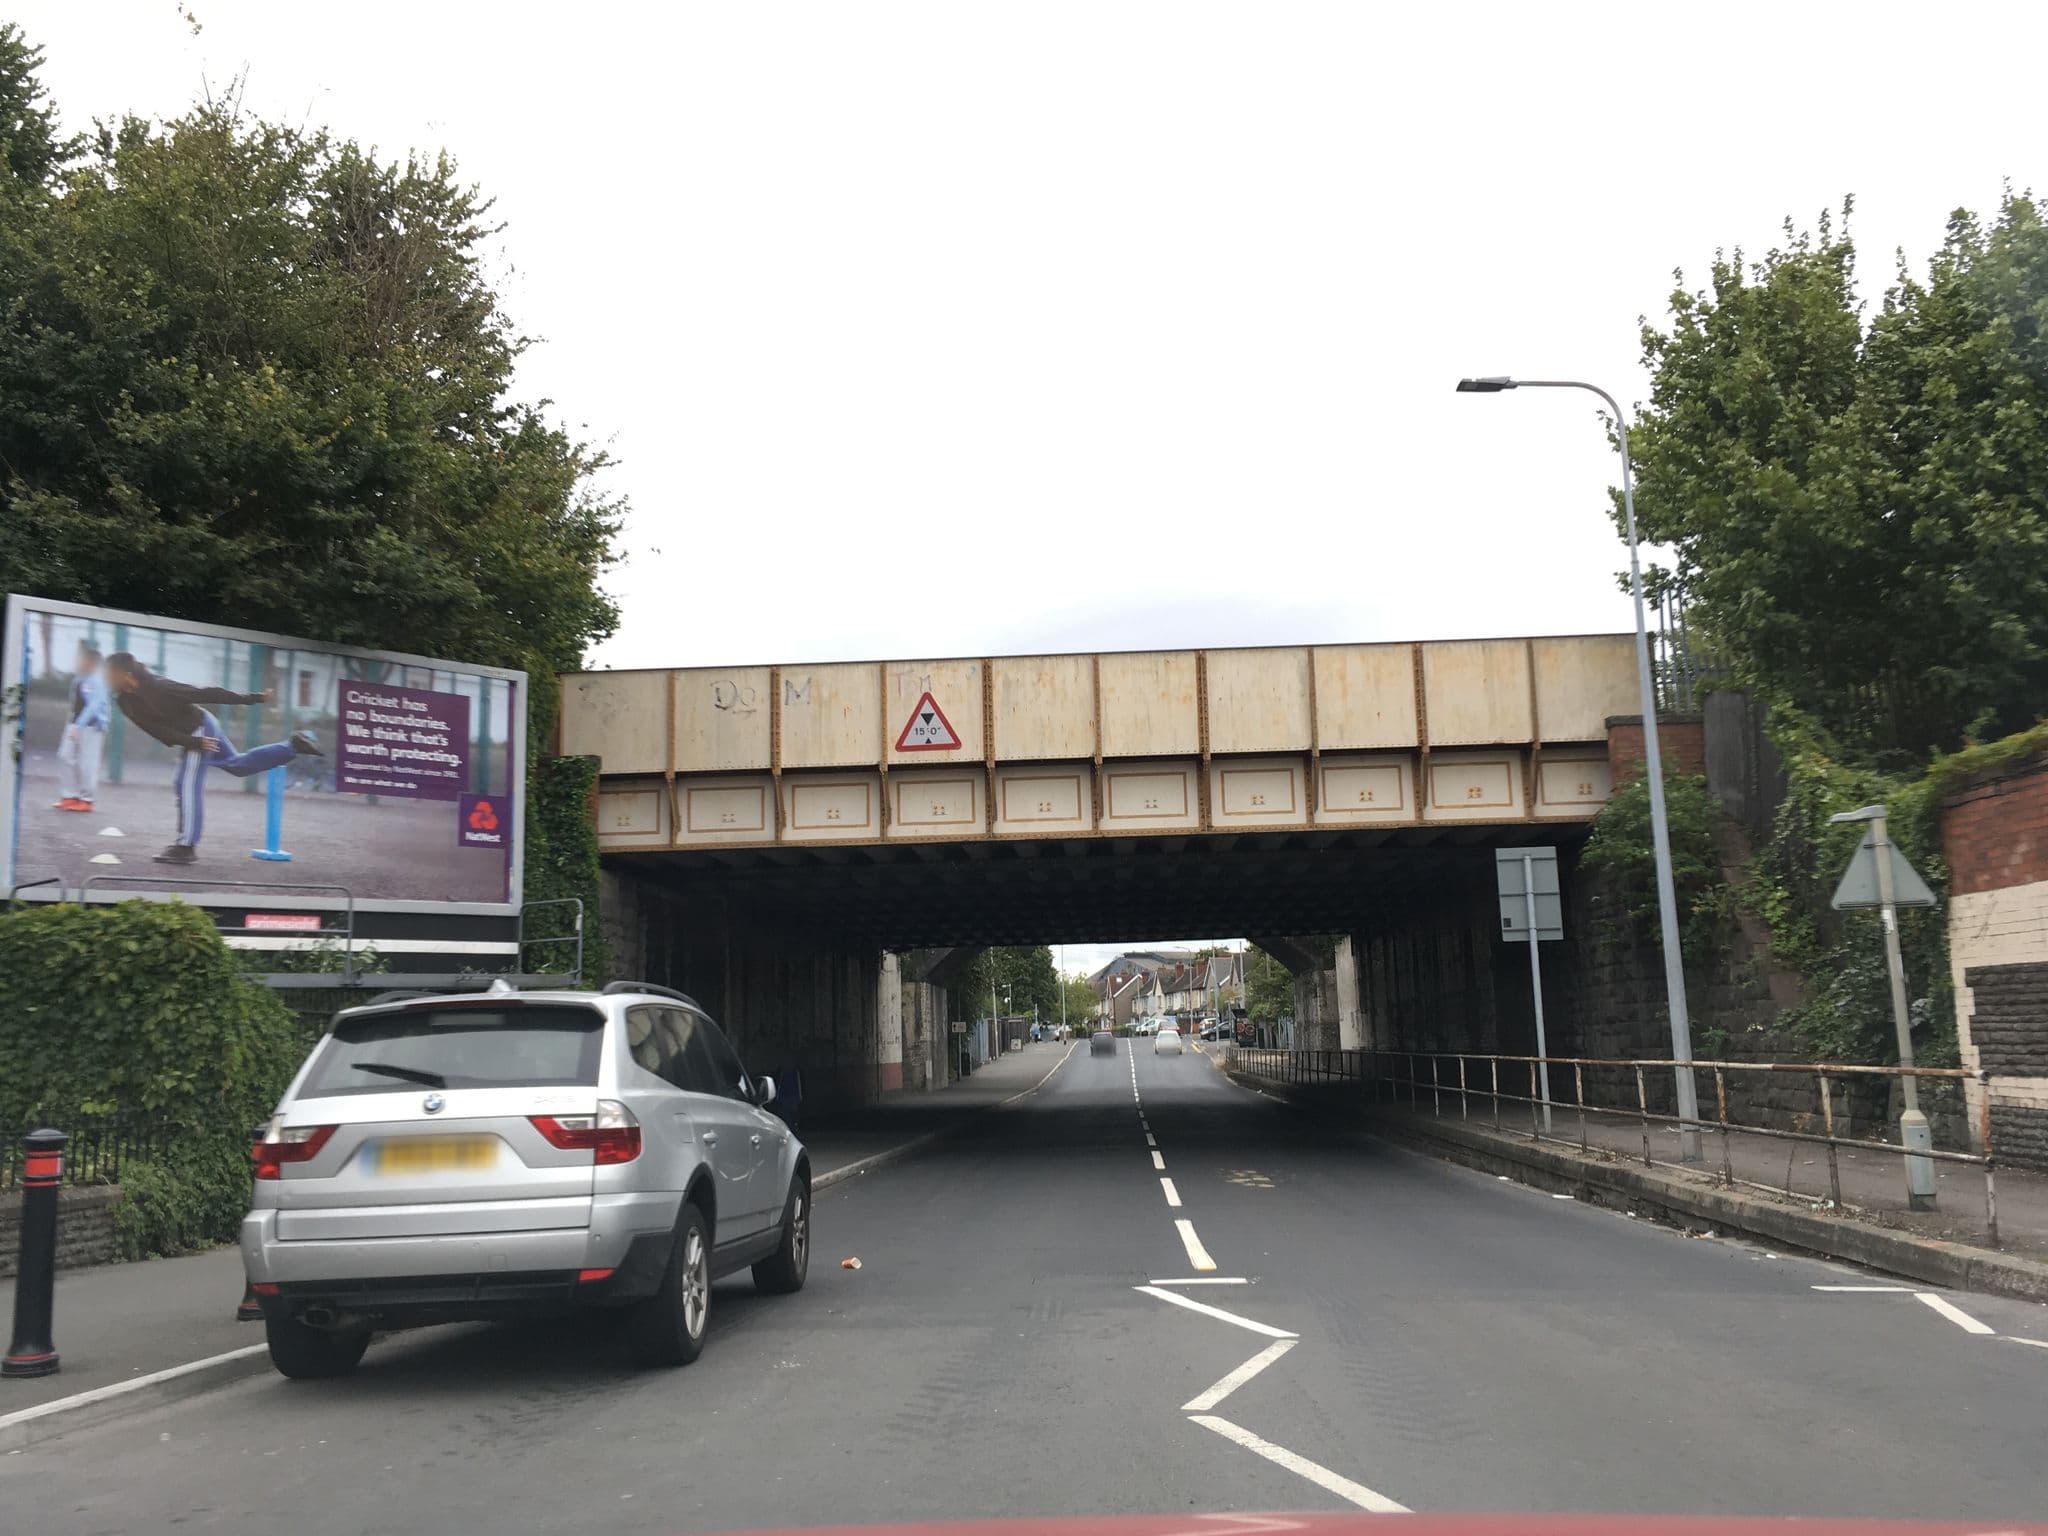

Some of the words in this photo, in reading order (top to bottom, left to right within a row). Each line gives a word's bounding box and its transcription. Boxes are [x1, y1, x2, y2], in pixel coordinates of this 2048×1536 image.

[346, 690, 400, 709] Cricket
[402, 696, 429, 712] has
[345, 710, 367, 721] no
[369, 708, 451, 731] boundaries.
[345, 723, 371, 738] We
[372, 726, 409, 742] think
[411, 731, 449, 747] that's
[345, 743, 389, 756] worth
[390, 748, 463, 767] protecting.
[344, 776, 357, 784] We
[465, 831, 501, 843] NatWest
